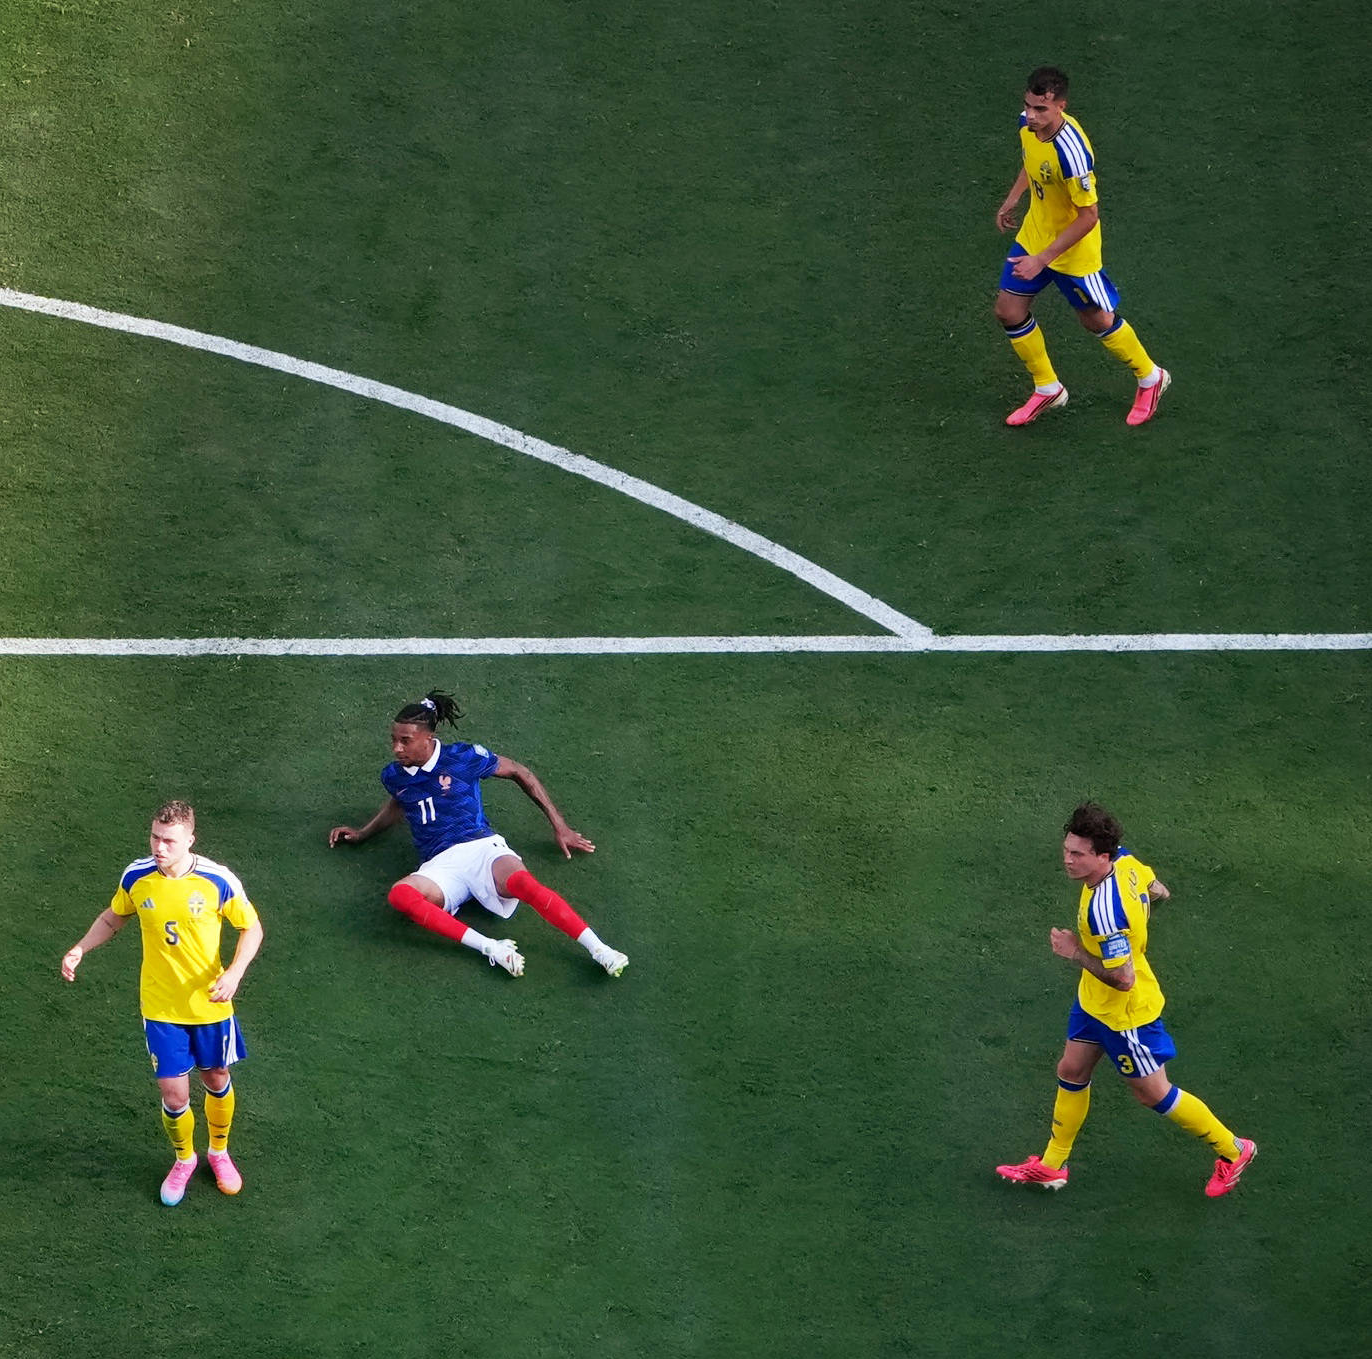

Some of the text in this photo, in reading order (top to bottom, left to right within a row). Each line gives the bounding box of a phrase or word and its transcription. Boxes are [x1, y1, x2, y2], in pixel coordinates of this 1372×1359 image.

[1030, 176, 1044, 201] 8
[417, 796, 436, 825] 11
[165, 920, 178, 946] 5
[1118, 1054, 1134, 1074] 3
